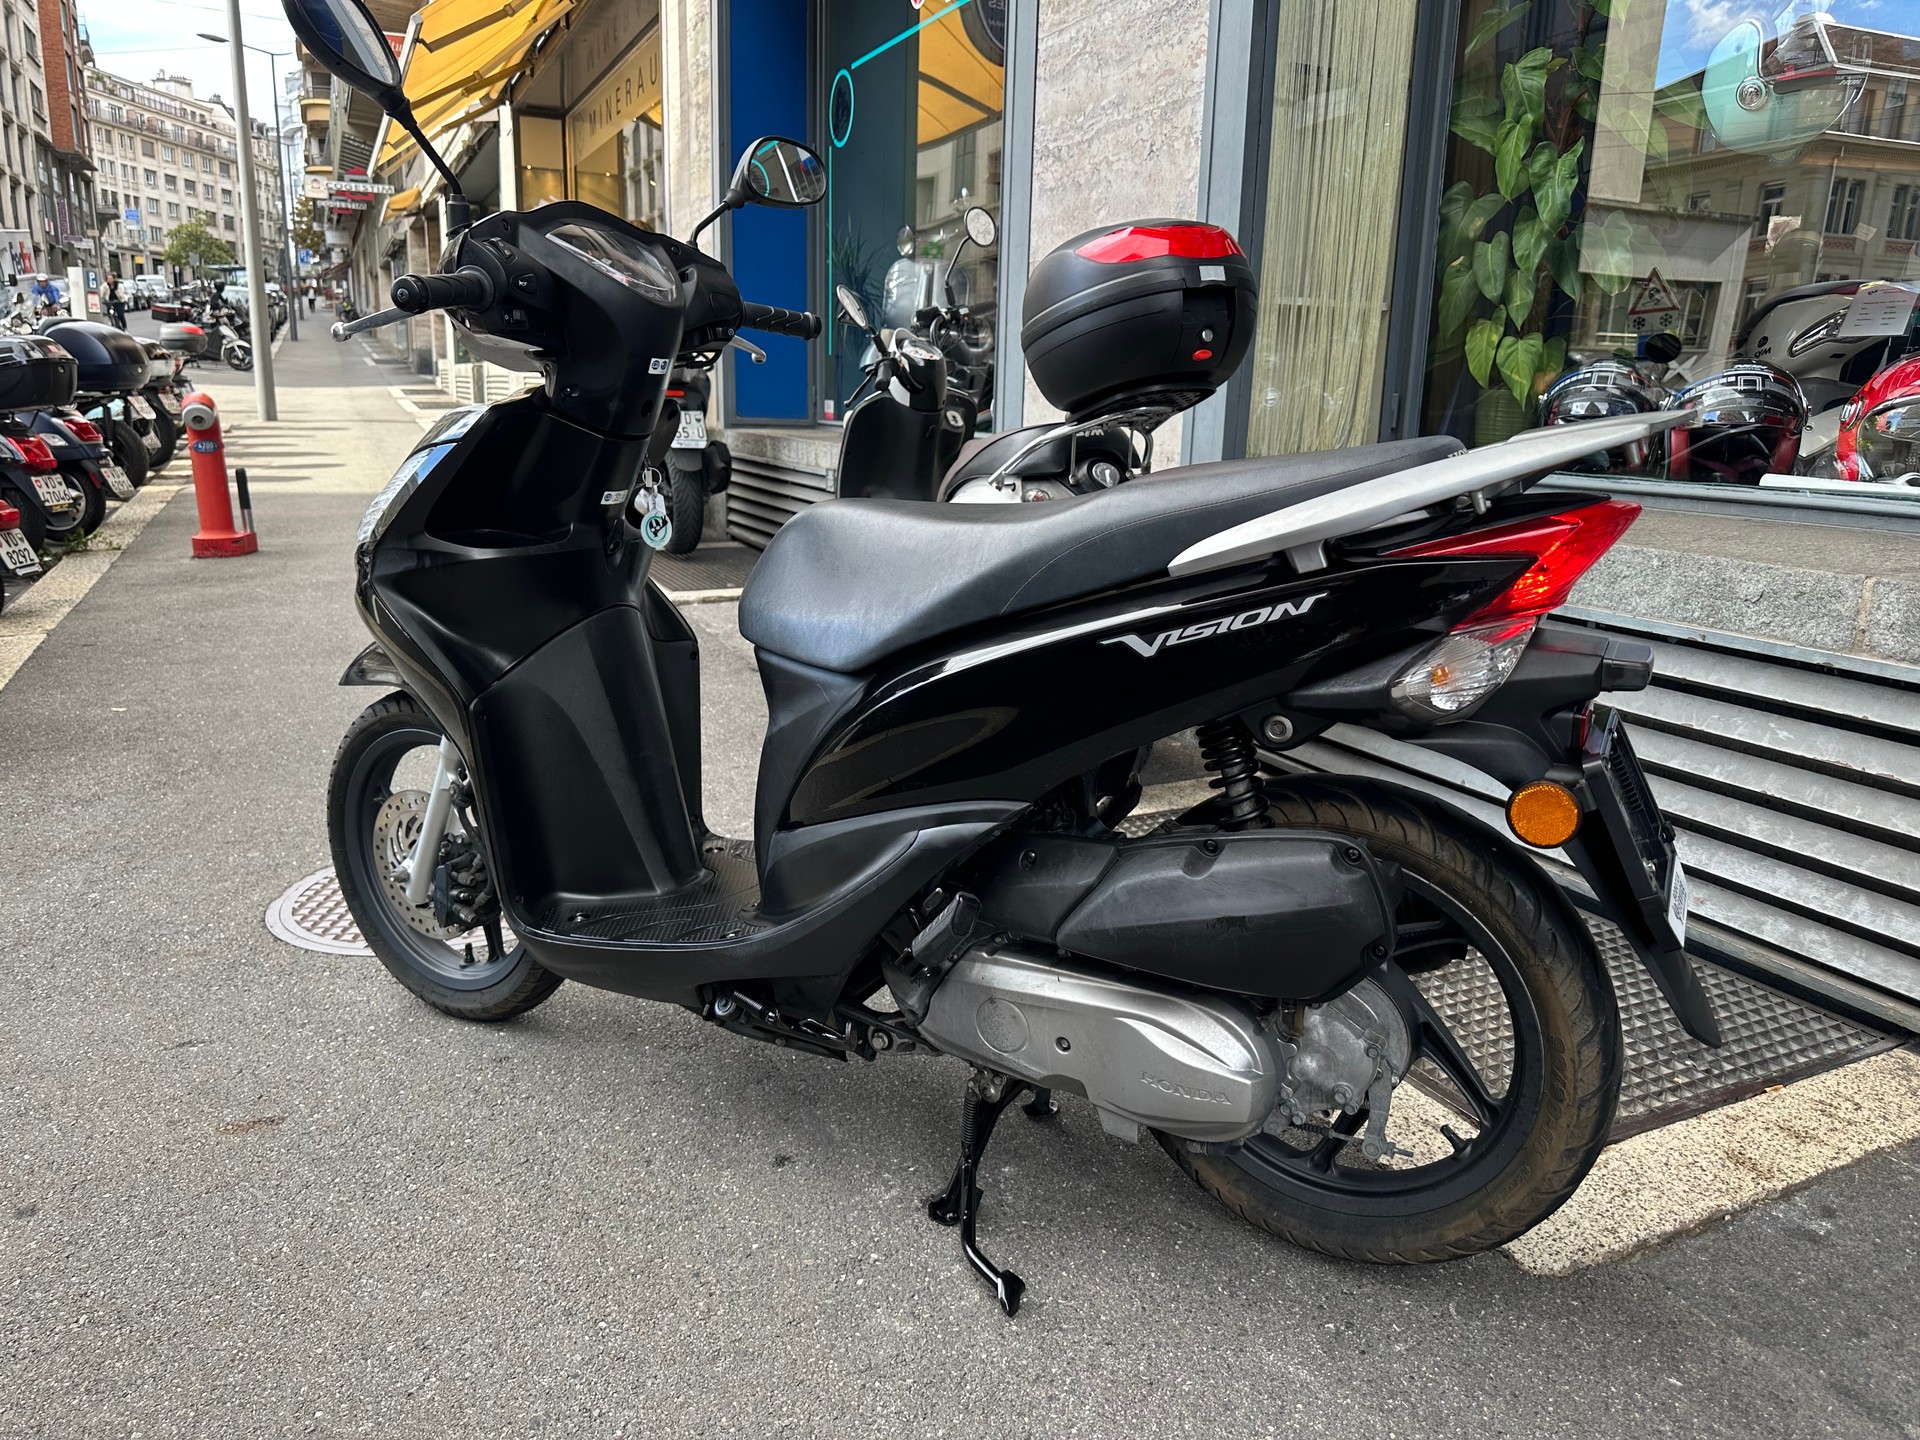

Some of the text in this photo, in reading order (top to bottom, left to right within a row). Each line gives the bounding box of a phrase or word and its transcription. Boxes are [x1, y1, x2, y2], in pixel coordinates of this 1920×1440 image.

[41, 476, 57, 489] VD
[41, 488, 72, 503] 47046
[1, 531, 19, 548] VD
[6, 547, 35, 566] 8292
[1100, 592, 1328, 658] VISION
[1139, 1070, 1233, 1106] HONDA
